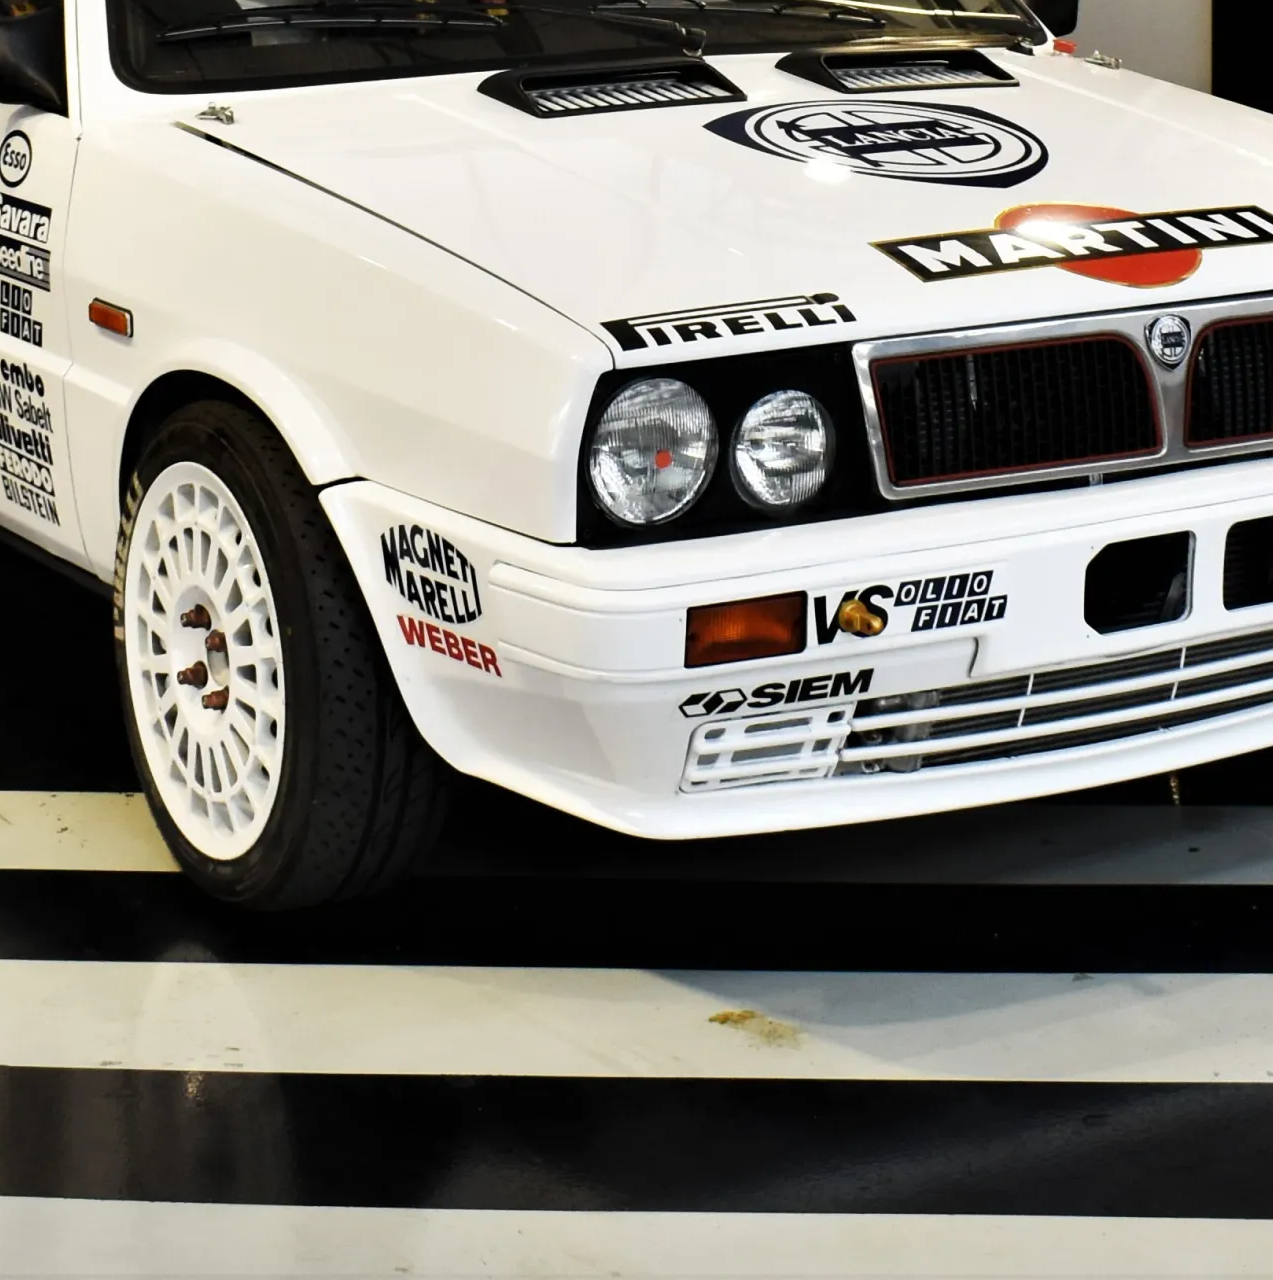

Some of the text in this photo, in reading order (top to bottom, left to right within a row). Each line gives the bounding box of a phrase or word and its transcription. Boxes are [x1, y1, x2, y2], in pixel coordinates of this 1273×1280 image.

[2, 143, 27, 171] Esso
[822, 125, 964, 148] LANCIA
[1, 311, 42, 347] FIAT
[599, 292, 857, 351] PIRELLI
[14, 389, 54, 434] Sabelt
[1, 474, 61, 526] BILSTEIN
[380, 524, 479, 586] MAGNETI
[385, 565, 483, 624] MARELLI
[899, 573, 989, 604] OLIO
[814, 584, 894, 645] VS
[917, 598, 1005, 628] FIAT
[397, 614, 503, 678] WEBER
[747, 668, 874, 708] SIEM
